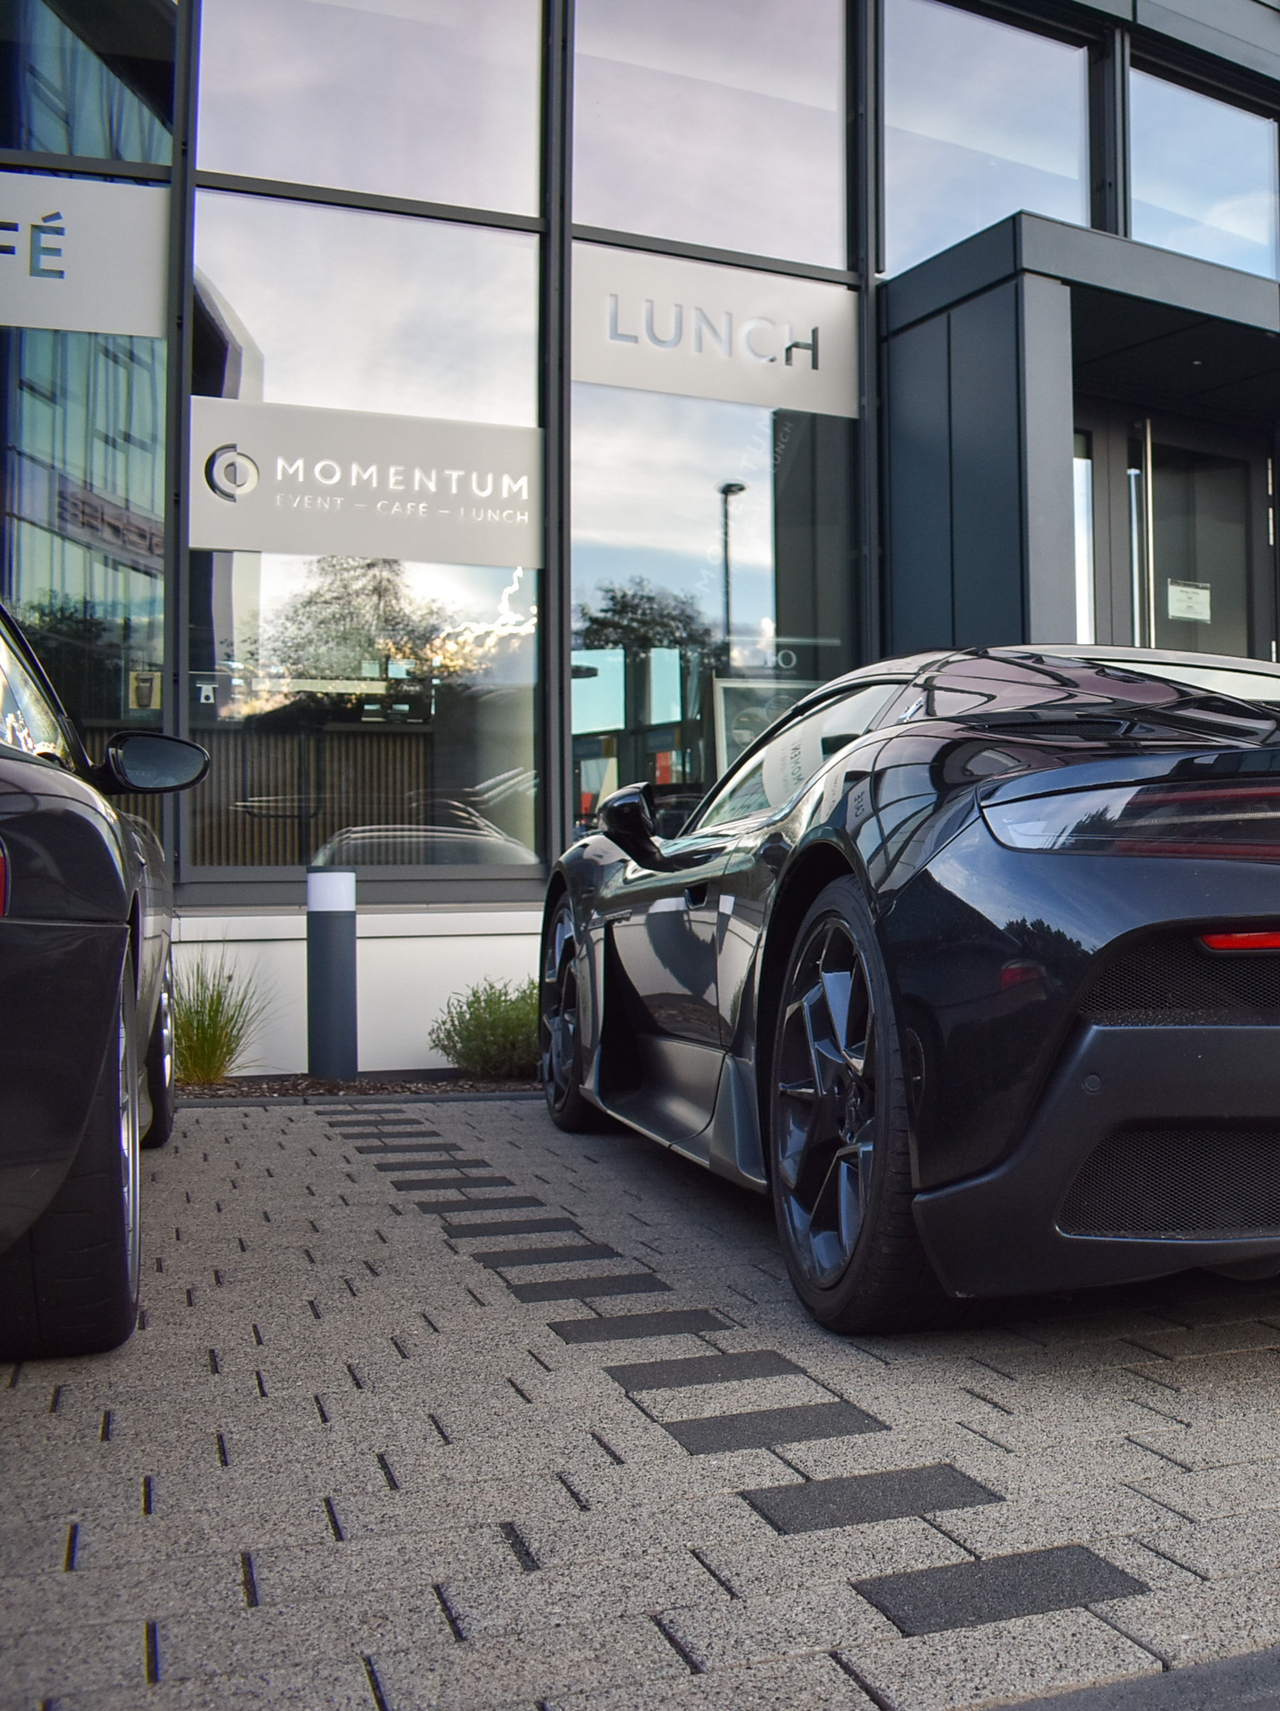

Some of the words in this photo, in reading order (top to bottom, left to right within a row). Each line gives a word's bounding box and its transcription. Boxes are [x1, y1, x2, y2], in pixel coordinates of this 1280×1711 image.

[608, 293, 820, 371] LUNCH
[274, 455, 530, 500] MOMENTUM
[275, 493, 345, 511] EVENT
[376, 499, 429, 518] CAFÉ
